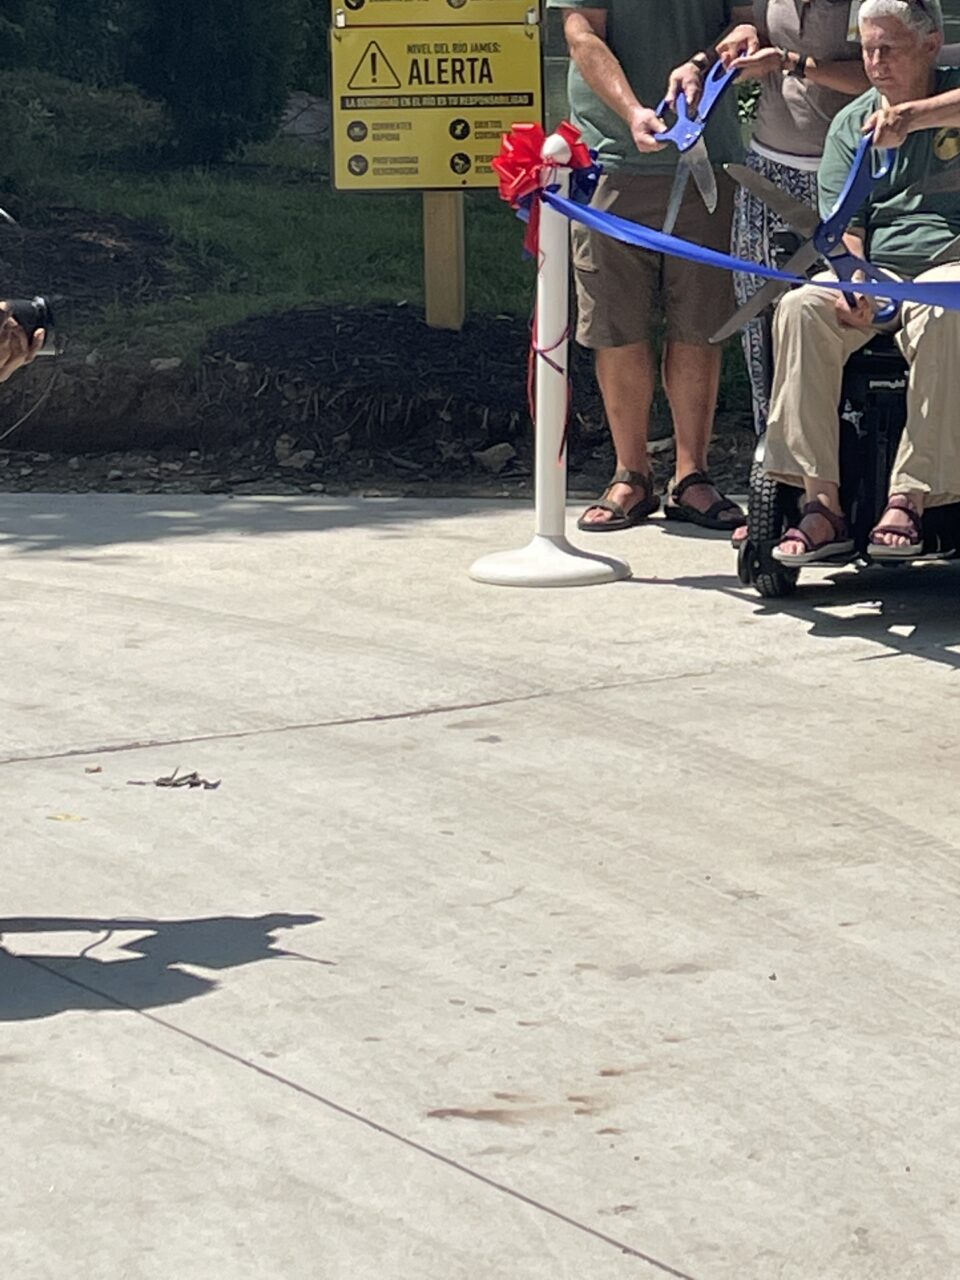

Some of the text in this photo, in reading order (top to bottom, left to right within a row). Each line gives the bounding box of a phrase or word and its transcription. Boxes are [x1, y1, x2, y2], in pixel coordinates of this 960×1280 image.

[407, 43, 432, 54] NIVEL
[434, 43, 450, 54] DEL
[407, 57, 494, 85] ALERTA
